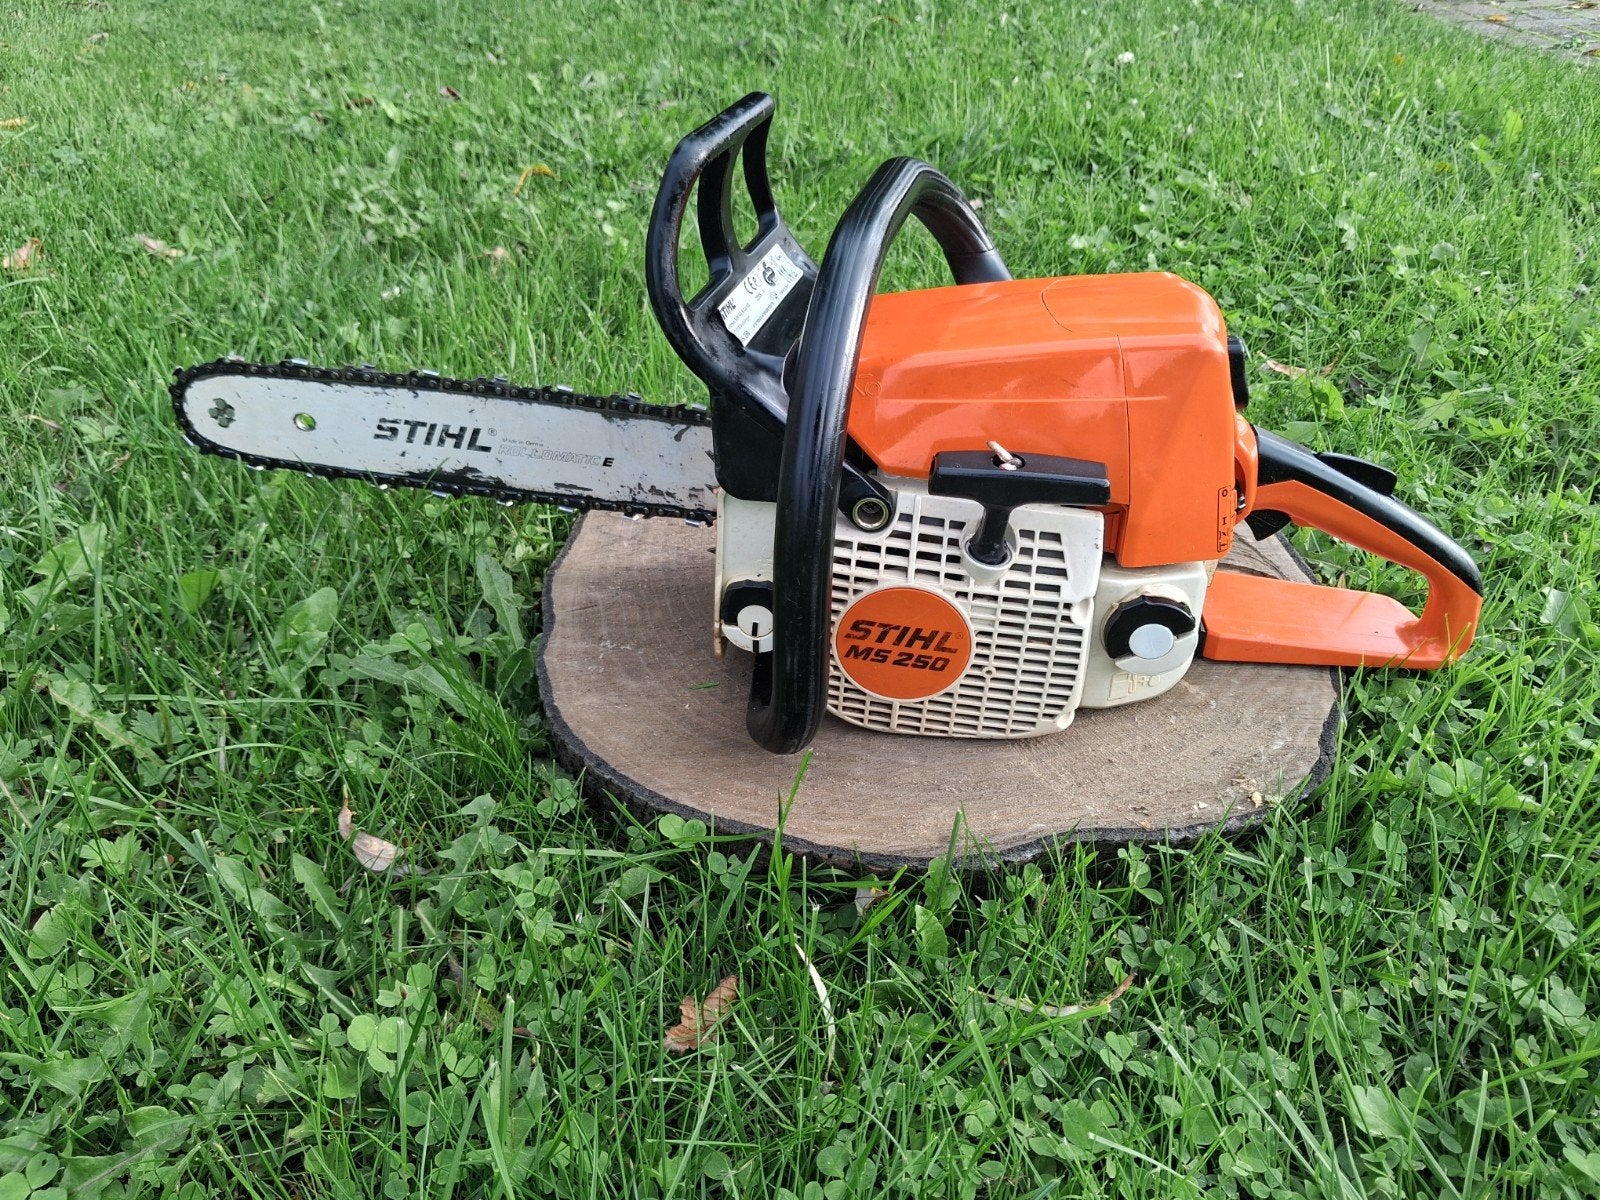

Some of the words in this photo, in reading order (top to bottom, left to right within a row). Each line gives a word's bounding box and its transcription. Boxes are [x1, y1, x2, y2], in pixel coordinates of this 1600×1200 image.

[373, 417, 492, 453] STIHL
[498, 444, 601, 466] ROLLOMATIC
[602, 457, 615, 467] E
[844, 619, 959, 654] STIHL
[843, 644, 893, 664] MS
[892, 652, 951, 672] 250
